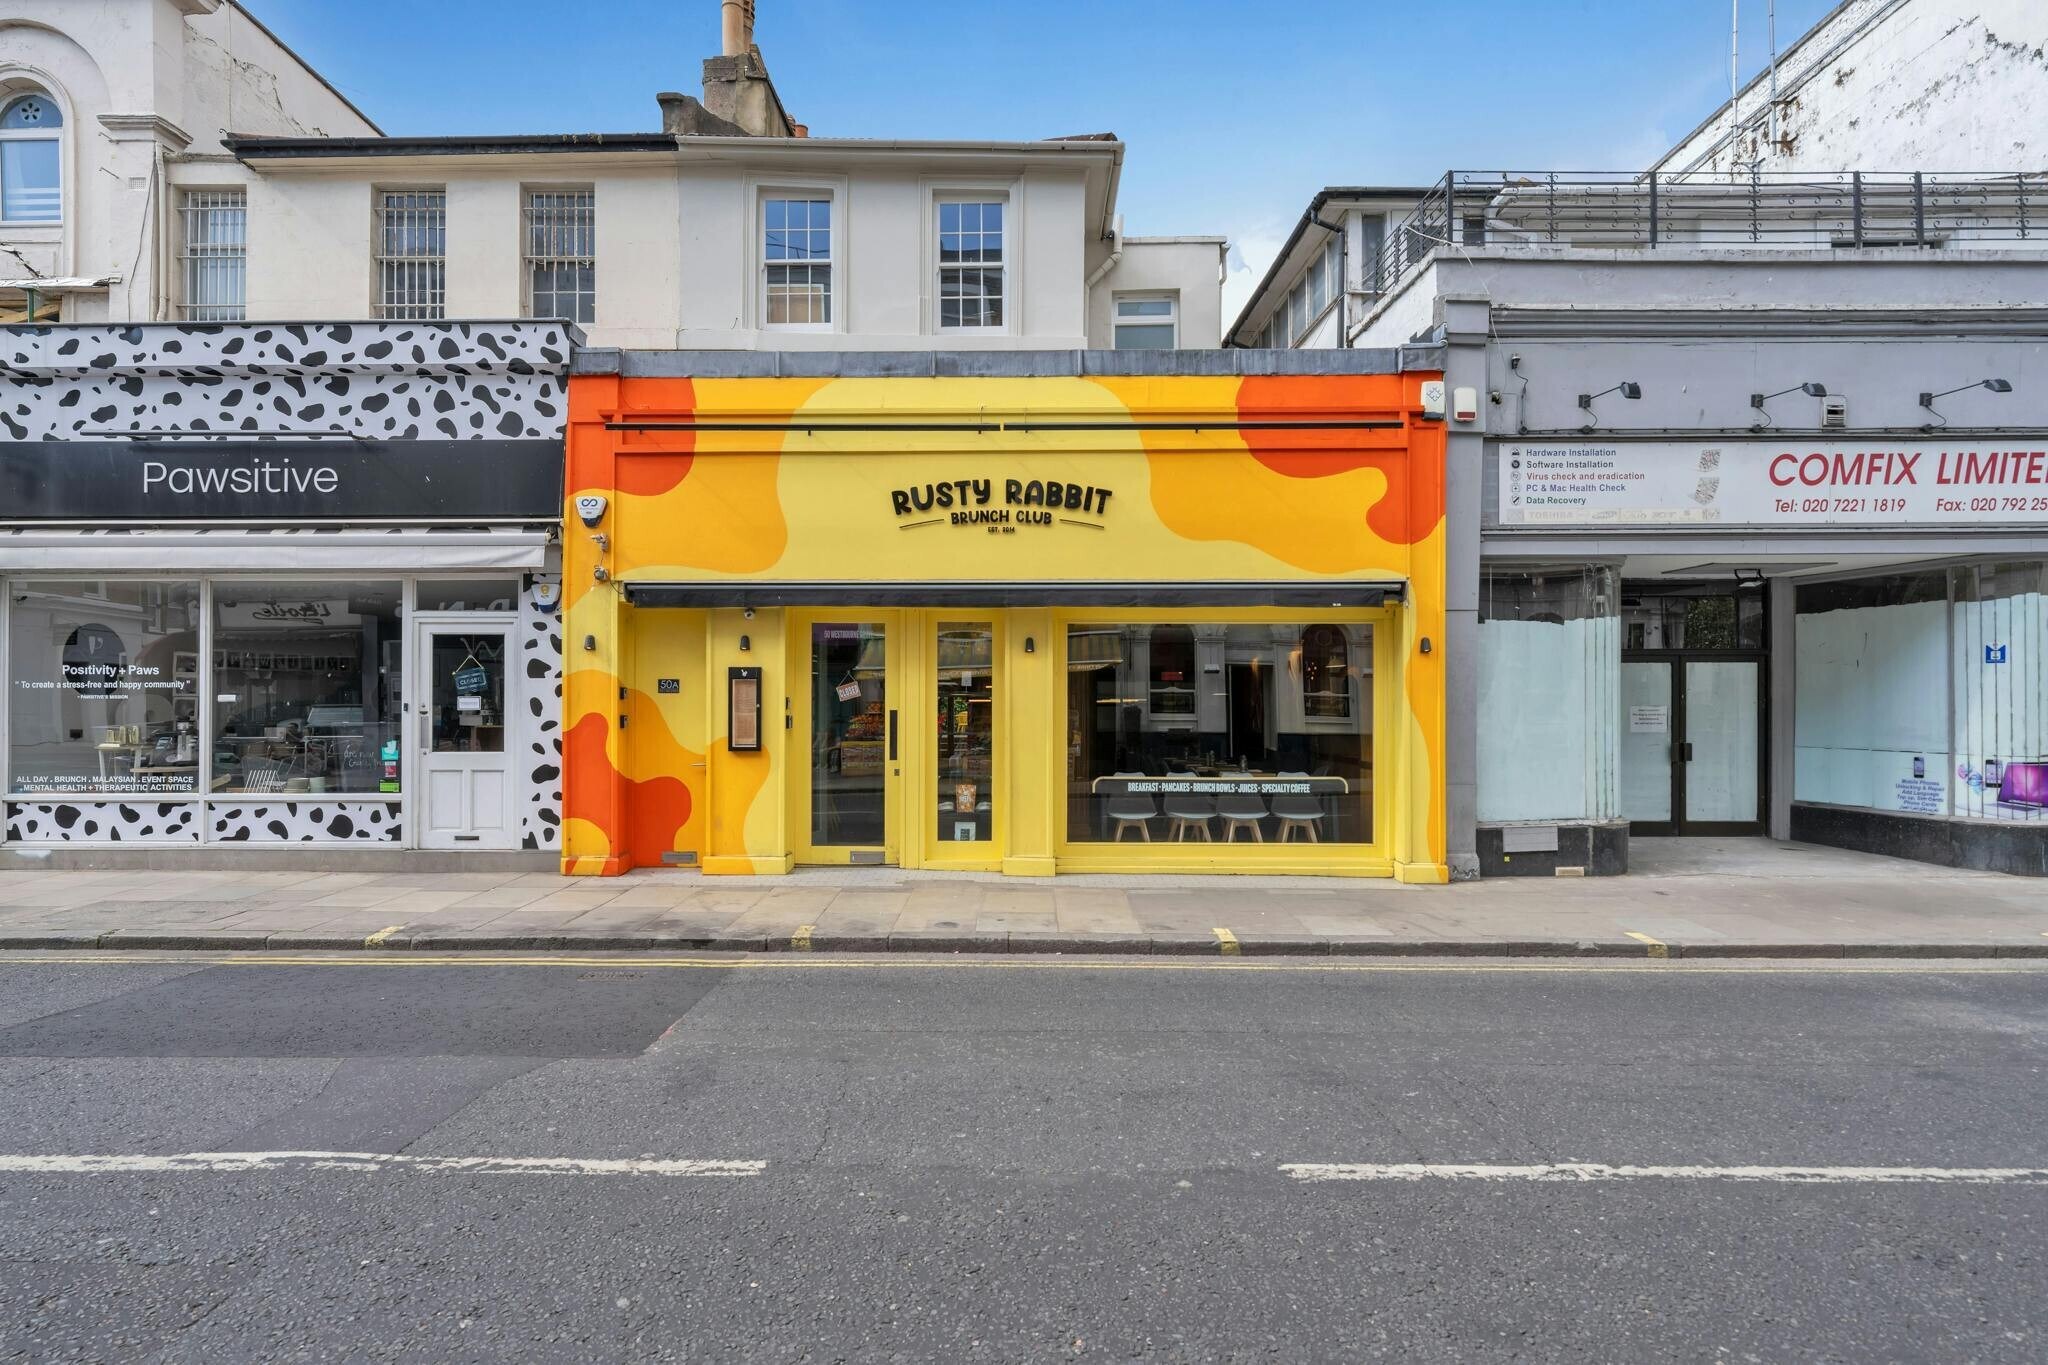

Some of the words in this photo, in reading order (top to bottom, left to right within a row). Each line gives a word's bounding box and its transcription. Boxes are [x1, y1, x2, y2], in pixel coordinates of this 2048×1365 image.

[1526, 448, 1566, 457] Hardware
[1569, 448, 1616, 457] Installation
[1526, 460, 1564, 469] Software
[1566, 460, 1614, 469] Installation
[1769, 452, 1922, 486] COMFIX
[1936, 452, 2048, 484] LIMITE
[143, 458, 339, 493] Pawsitive
[1526, 472, 1549, 481] Virus
[1551, 472, 1577, 481] check
[1579, 472, 1595, 480] and
[1597, 471, 1645, 480] eradication
[1526, 484, 1538, 492] PC
[1541, 484, 1547, 492] &
[1550, 484, 1567, 492] Mac
[1569, 484, 1597, 492] Health
[1599, 483, 1627, 492] Check
[891, 478, 991, 515] RUSTY
[1005, 478, 1113, 514] RABBIT
[1526, 496, 1545, 505] Data
[1547, 496, 1587, 506] Recovery
[1775, 499, 1798, 513] Tel:
[1802, 499, 1829, 513] 020
[1834, 499, 1866, 513] 7221
[1873, 499, 1906, 513] 1819
[1936, 498, 1966, 513] Fax:
[1971, 498, 1997, 512] 020
[2002, 498, 2027, 512] 792
[2031, 497, 2048, 511] 25
[951, 510, 1010, 526] BRUNCH
[1016, 510, 1053, 526] CLUB
[62, 664, 118, 677] Positivity
[128, 664, 160, 675] Paws
[21, 680, 30, 689] To
[31, 681, 55, 689] create
[62, 680, 102, 689] stress-free
[104, 681, 118, 689] and
[119, 680, 142, 690] happy
[144, 680, 185, 690] community
[660, 680, 679, 689] 50A
[839, 684, 860, 699] CLOSED
[16, 775, 32, 783] ALL
[33, 775, 49, 783] DAY
[54, 775, 87, 783] BRUNCH
[92, 775, 136, 783] MALAYSIAN
[141, 775, 167, 783] EVENT
[168, 775, 194, 783] SPACE
[23, 784, 54, 792] MENTAL
[56, 784, 87, 792] HEALTH
[1127, 782, 1159, 792] BREAKFAST
[1161, 783, 1190, 792] PANCAKES
[1193, 783, 1215, 792] BRUNCH
[1215, 784, 1235, 793] BOWLS
[1238, 784, 1258, 793] JUICES
[1261, 784, 1290, 793] SPECIALTY
[1290, 784, 1311, 793] COFFEE
